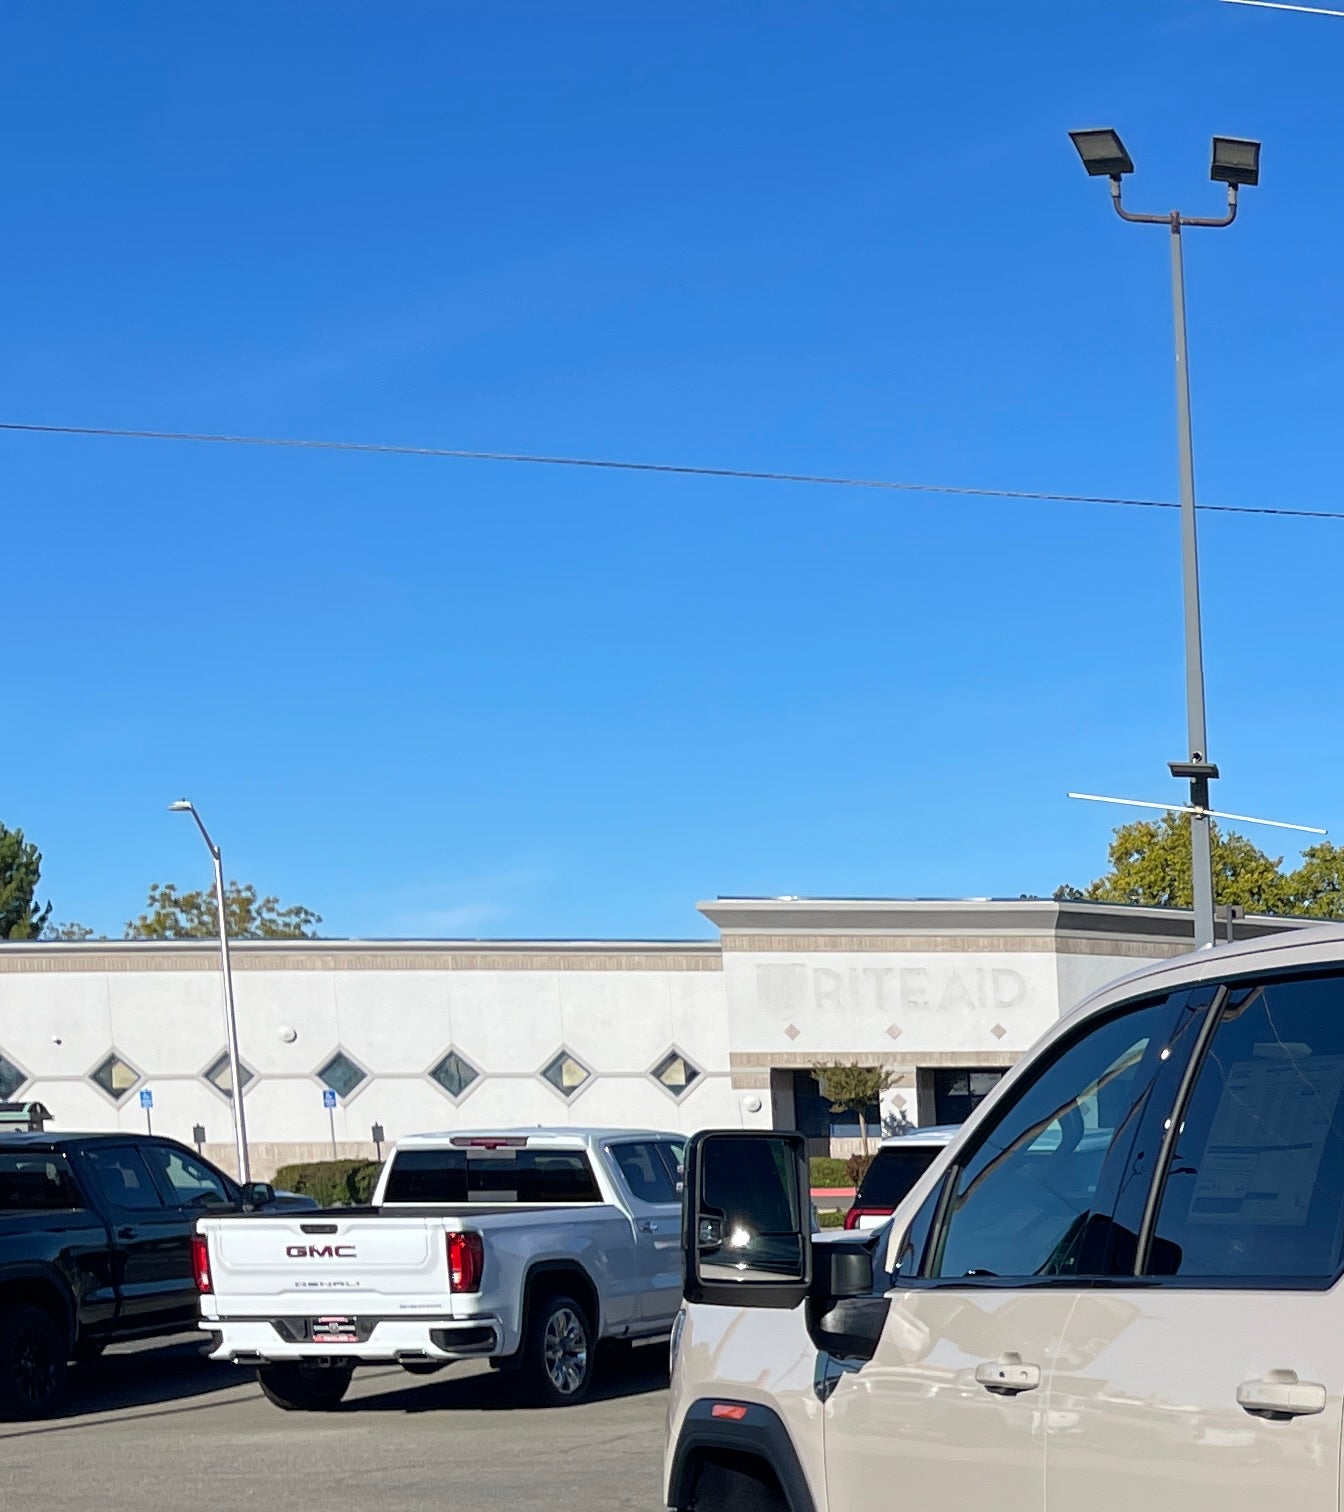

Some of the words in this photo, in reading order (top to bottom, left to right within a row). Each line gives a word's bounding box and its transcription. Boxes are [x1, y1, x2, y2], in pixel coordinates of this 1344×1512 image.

[813, 967, 929, 1010] RITE
[938, 967, 1027, 1010] AID
[285, 1245, 357, 1258] GMC
